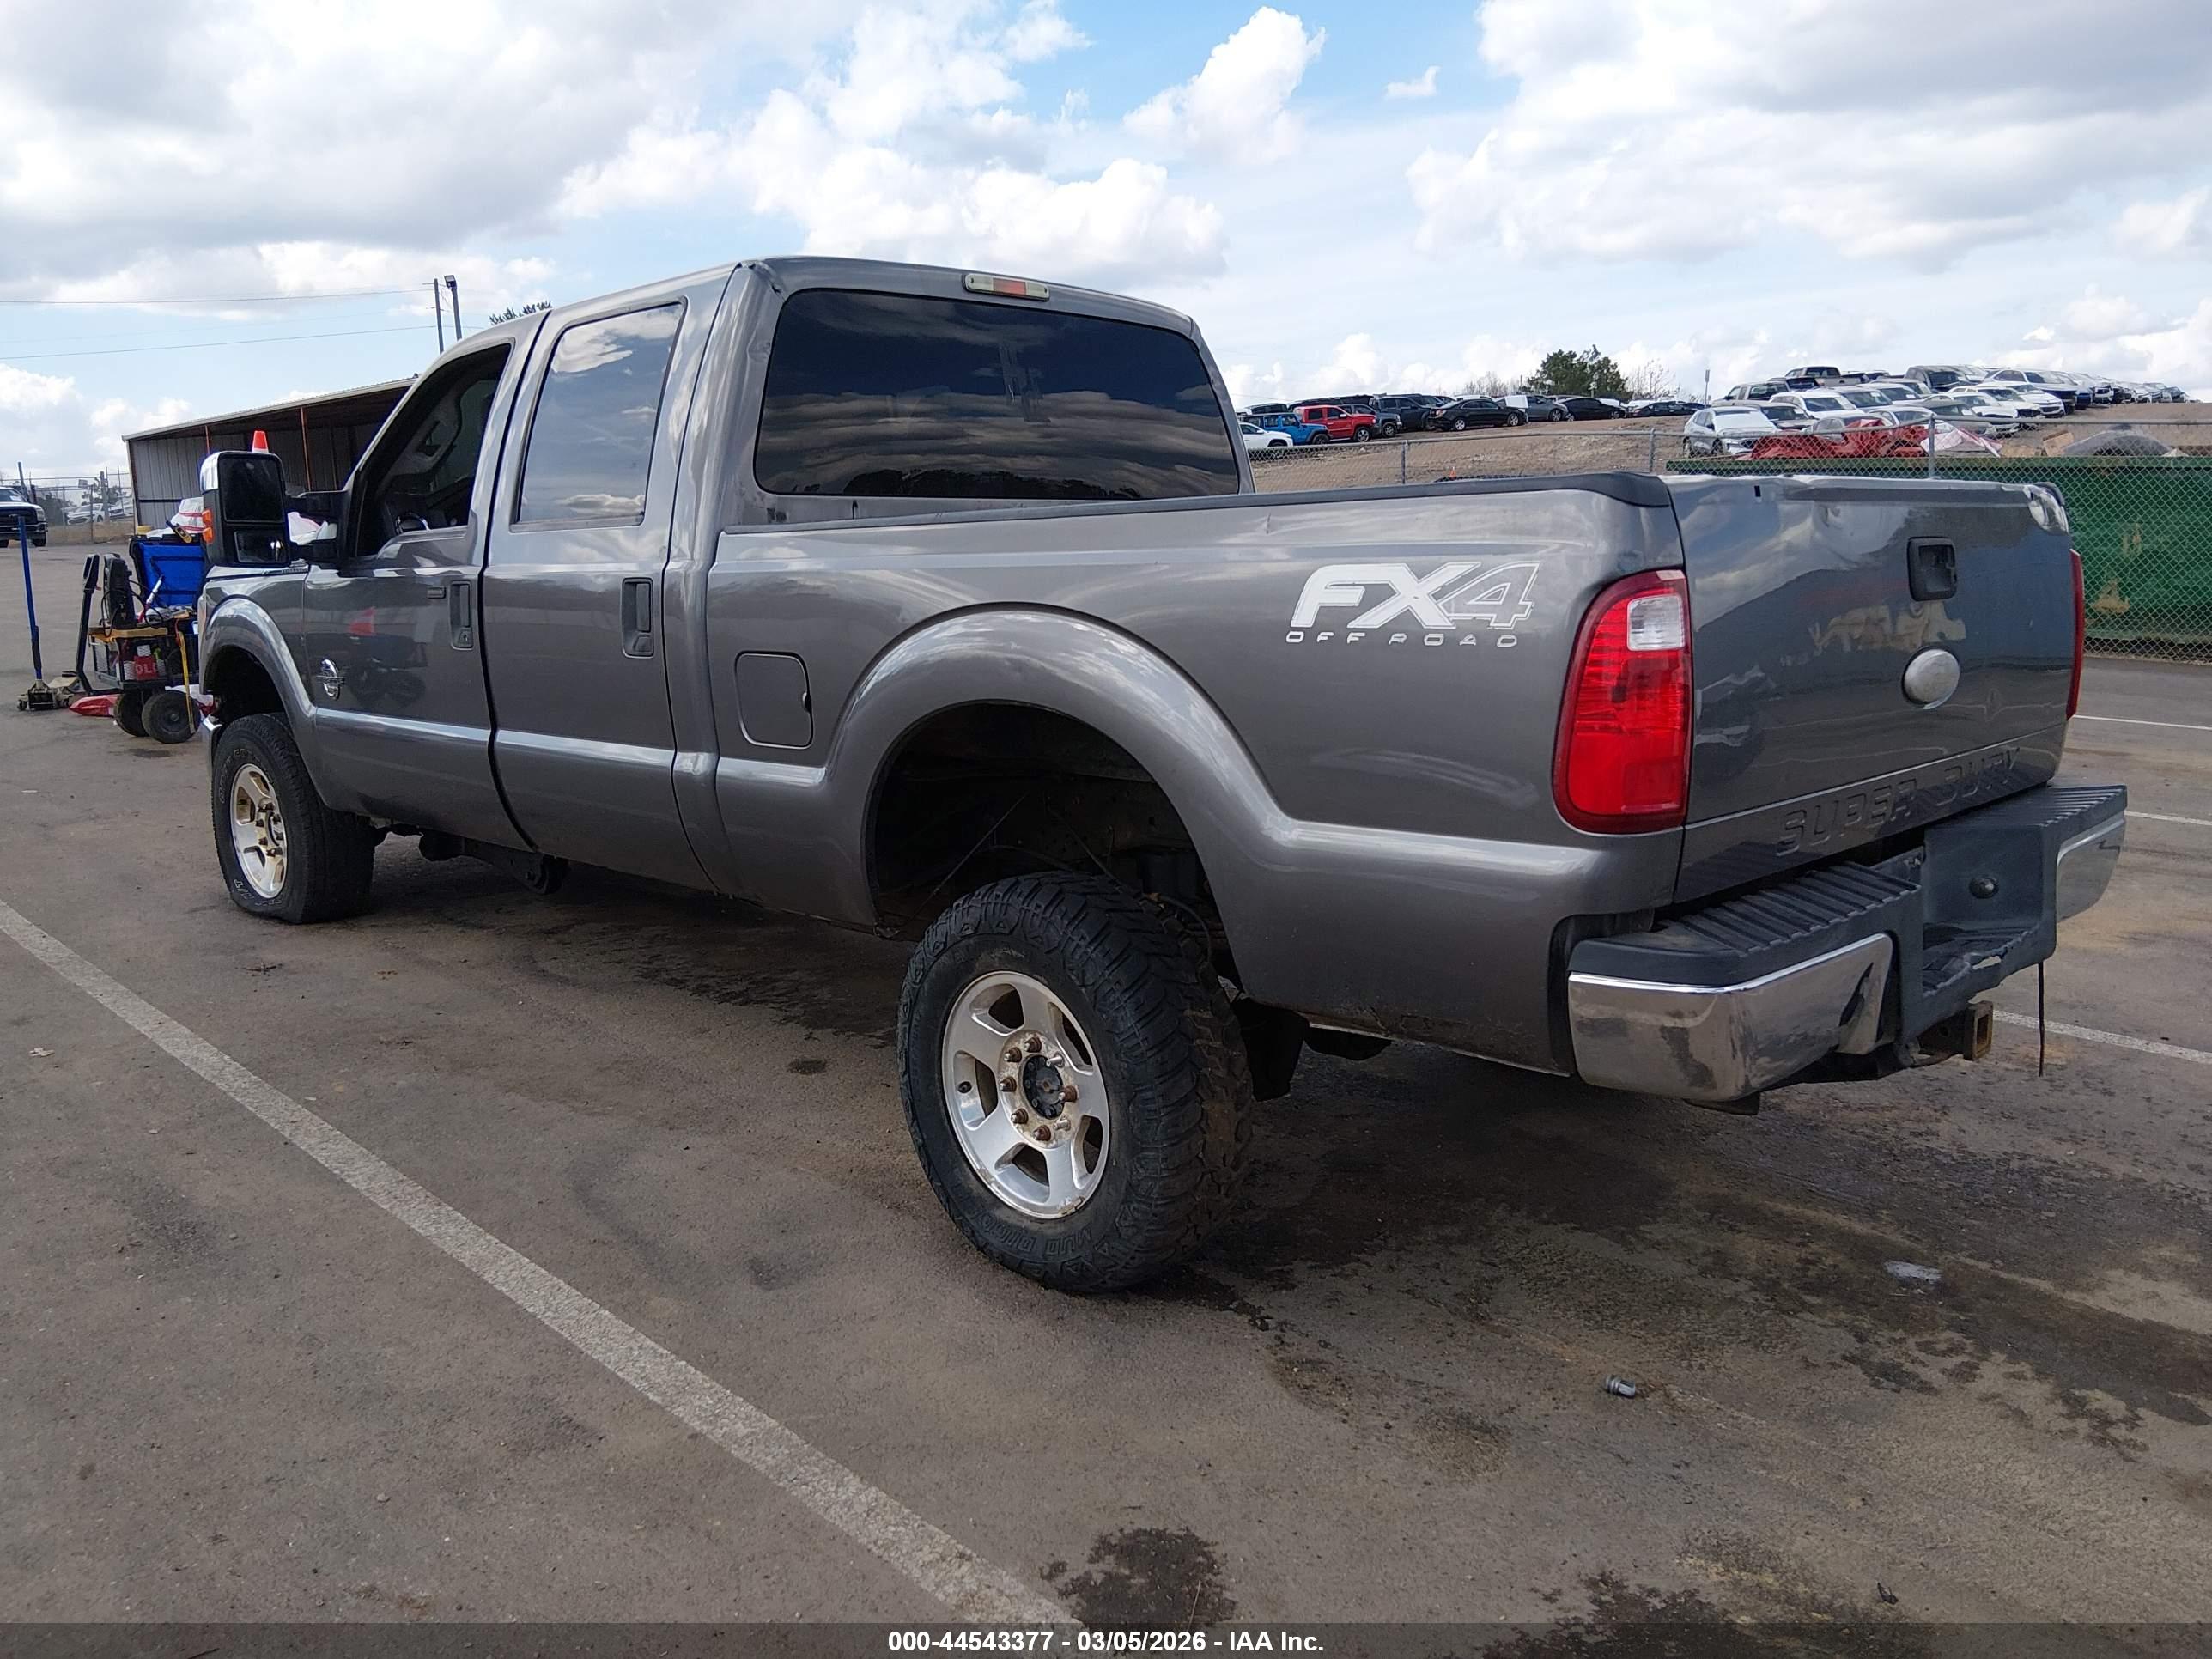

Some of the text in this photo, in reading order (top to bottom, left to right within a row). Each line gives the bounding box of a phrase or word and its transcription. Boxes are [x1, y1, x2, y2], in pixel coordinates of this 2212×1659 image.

[1290, 561, 1540, 629] FX4
[1285, 630, 1518, 648] OFF ROAD
